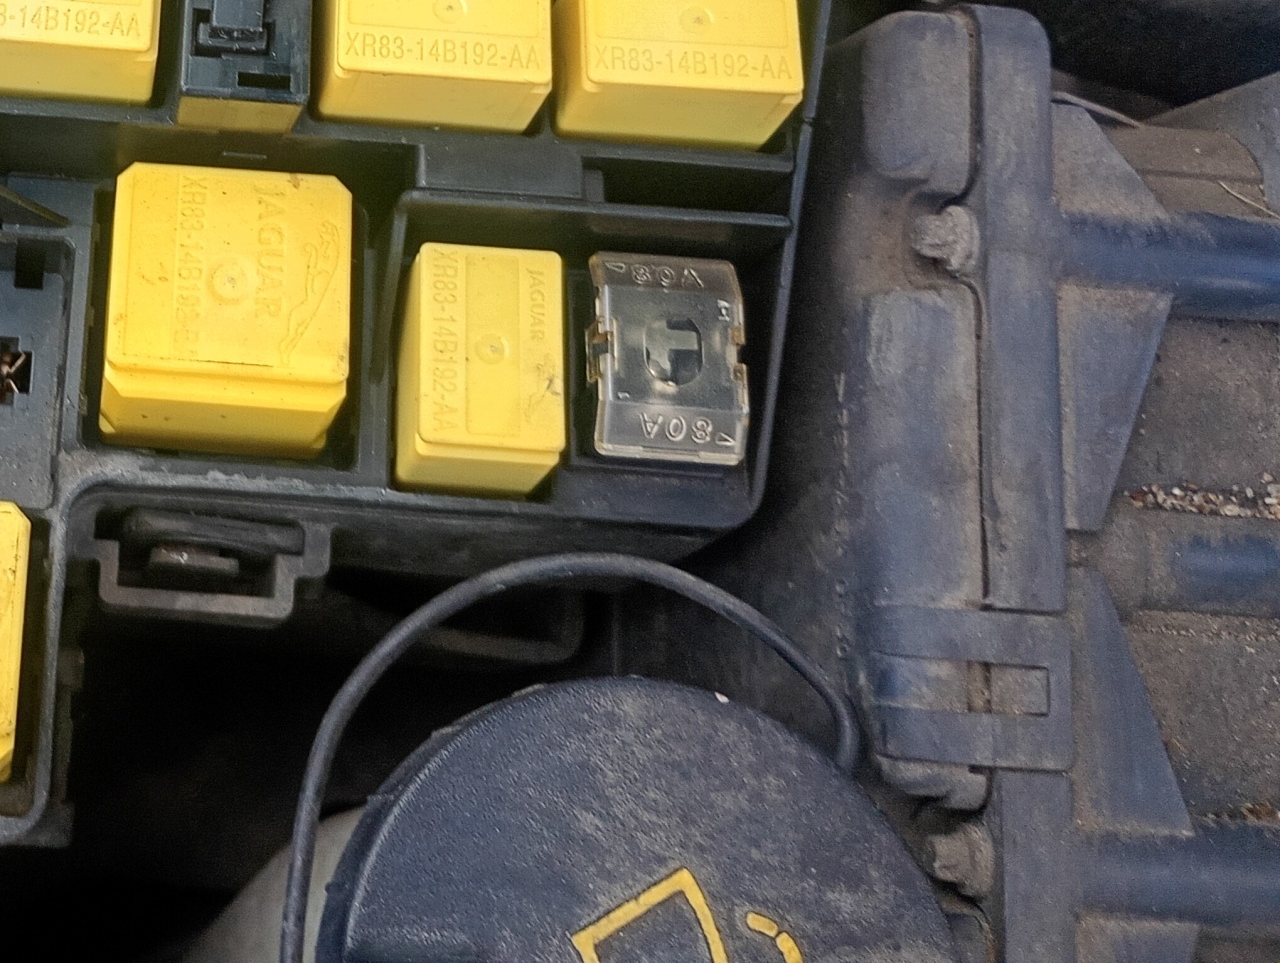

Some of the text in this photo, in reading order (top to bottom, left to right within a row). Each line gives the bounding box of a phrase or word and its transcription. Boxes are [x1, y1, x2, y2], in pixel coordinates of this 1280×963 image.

[345, 31, 541, 70] XR83-14B192-AA
[595, 44, 793, 81] XR83-14B192-AA
[254, 184, 287, 320] JAGUAR
[526, 266, 546, 342] JAGUAR
[431, 248, 459, 432] XR83-14B192-AA
[639, 411, 714, 444] 80A
